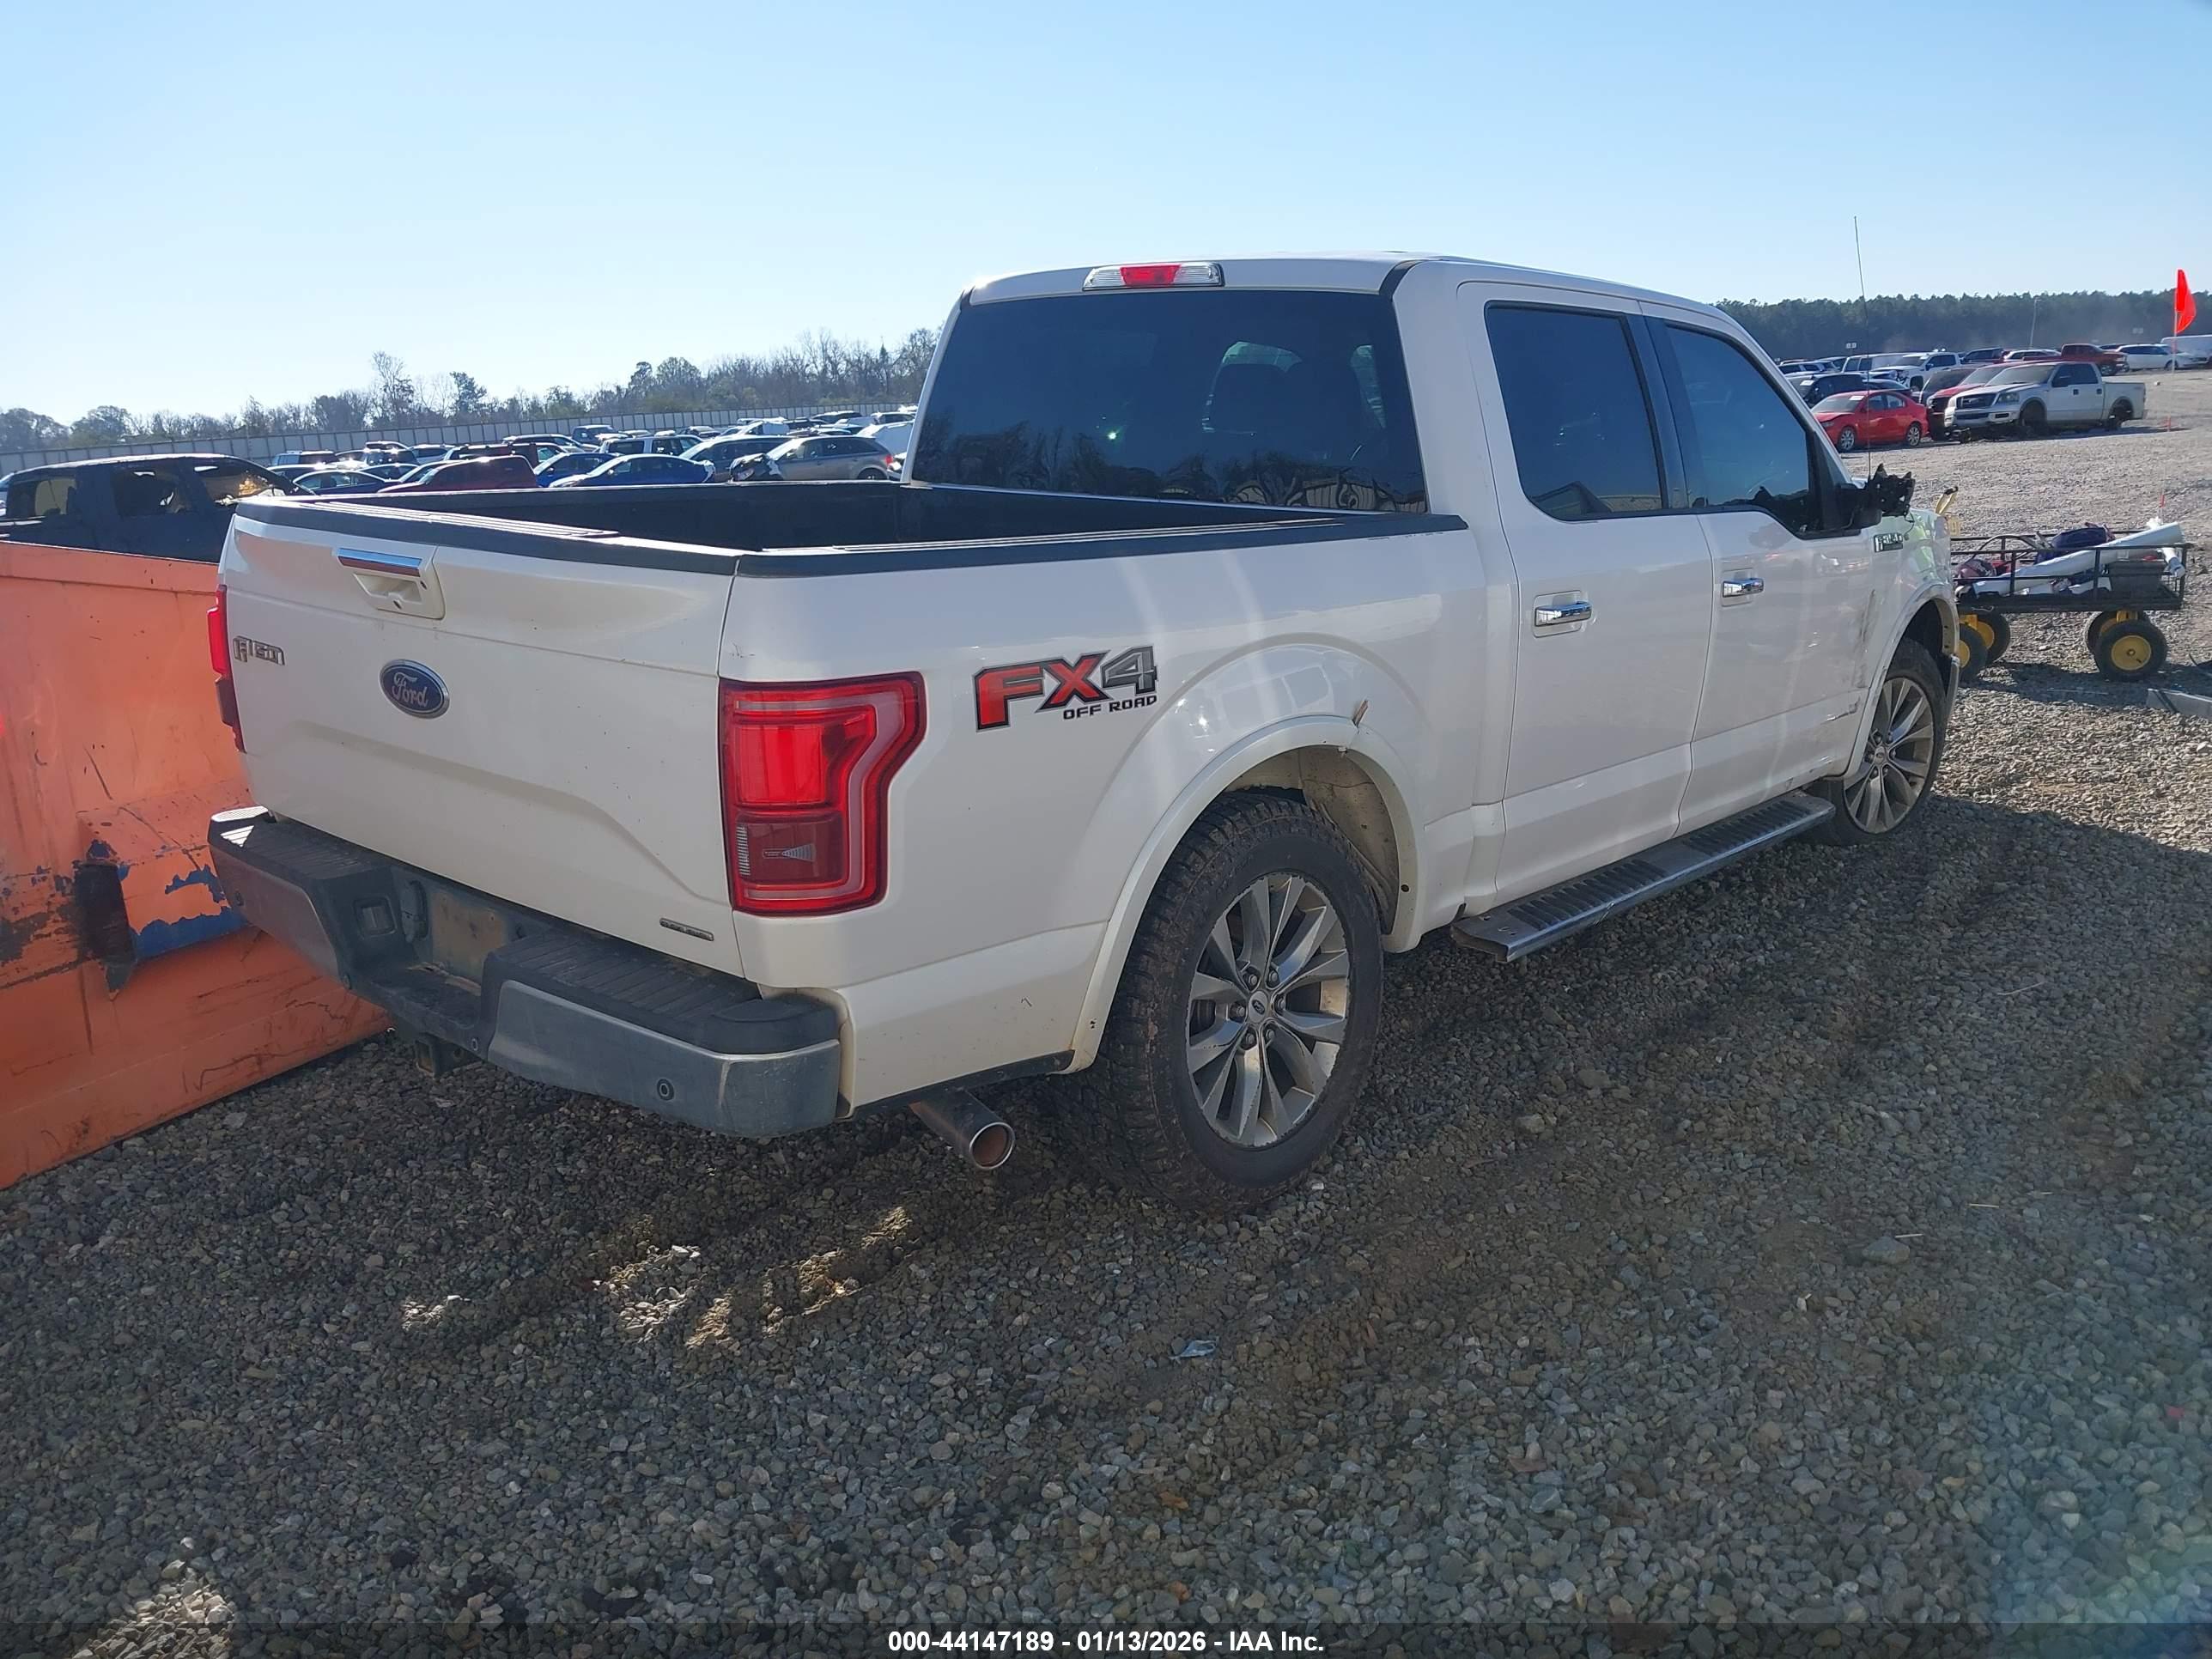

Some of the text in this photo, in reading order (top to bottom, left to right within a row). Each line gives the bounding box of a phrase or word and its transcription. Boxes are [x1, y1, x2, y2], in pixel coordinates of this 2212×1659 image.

[391, 672, 429, 708] Ford
[972, 645, 1158, 732] FX4
[1063, 695, 1158, 720] OFF ROAD
